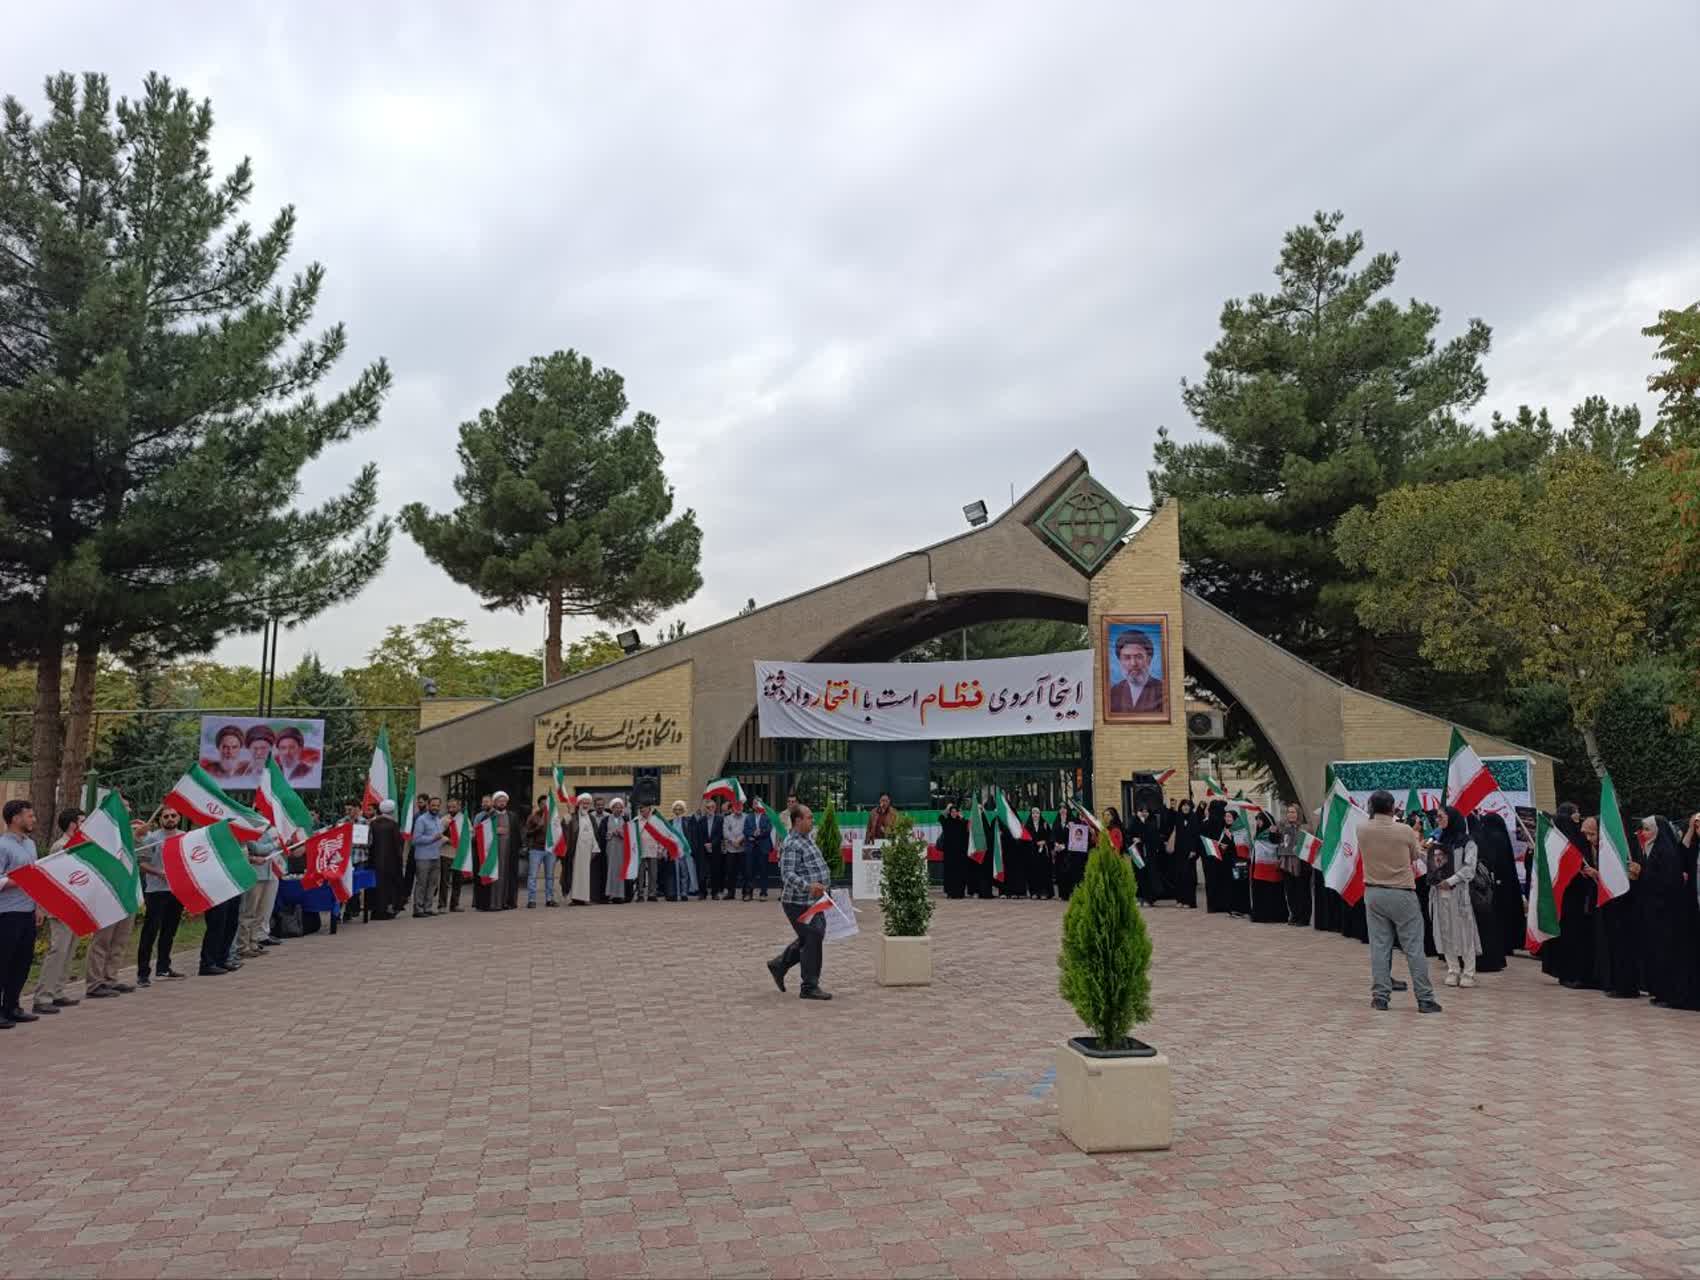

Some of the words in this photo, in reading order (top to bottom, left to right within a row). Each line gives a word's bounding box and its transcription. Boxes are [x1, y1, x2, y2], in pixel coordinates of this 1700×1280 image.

[809, 679, 858, 712] افتخار
[863, 690, 874, 725] با
[877, 689, 919, 710] است
[920, 678, 984, 727] نظام
[988, 674, 1051, 723] آبروی
[1048, 677, 1083, 720] اینجا
